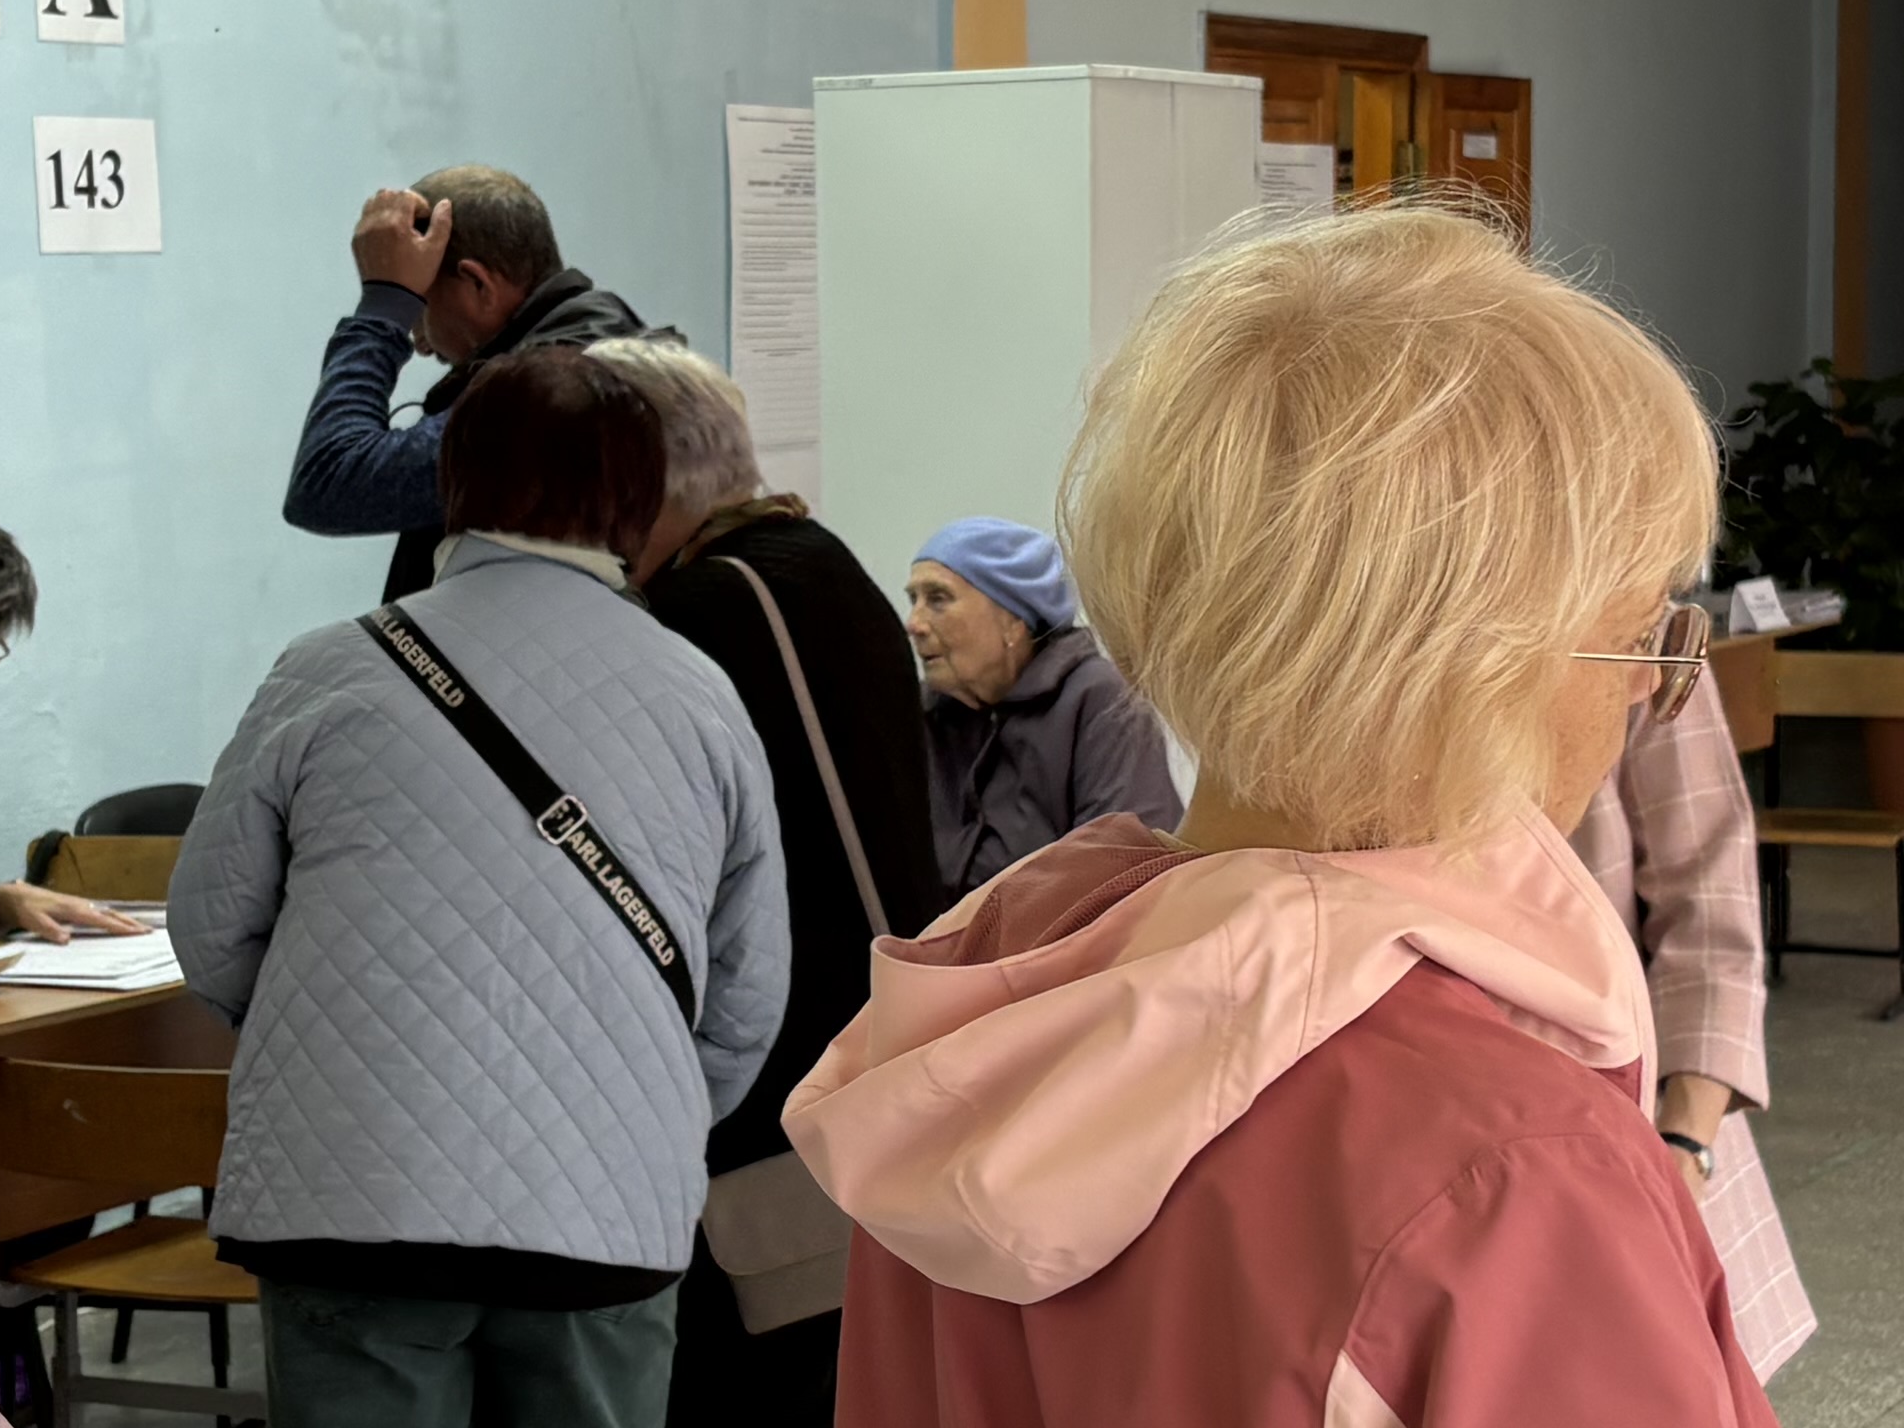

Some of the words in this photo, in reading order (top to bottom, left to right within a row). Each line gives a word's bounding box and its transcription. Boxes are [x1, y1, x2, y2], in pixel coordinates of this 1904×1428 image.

[45, 148, 126, 210] 143
[382, 620, 465, 708] LAGERFELD
[596, 863, 676, 967] LAGERFELD
